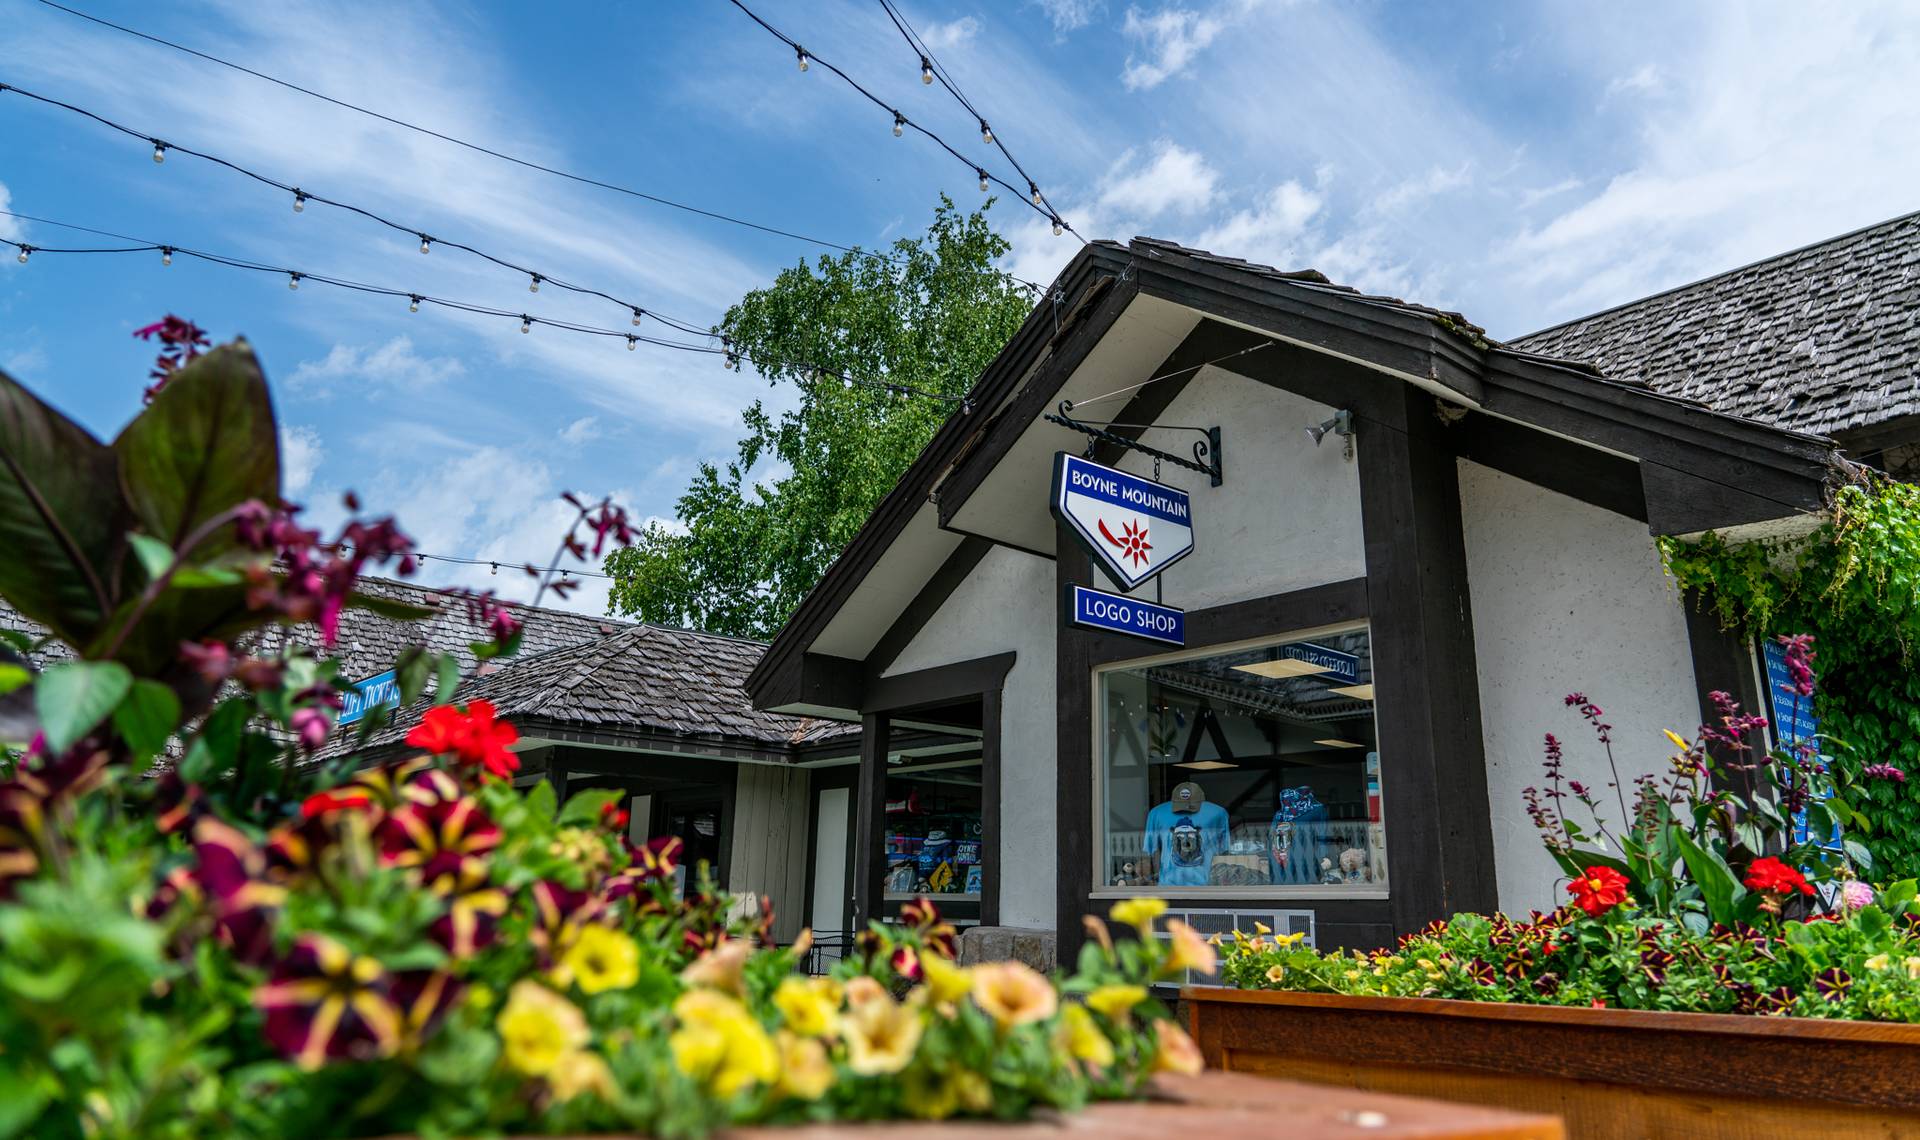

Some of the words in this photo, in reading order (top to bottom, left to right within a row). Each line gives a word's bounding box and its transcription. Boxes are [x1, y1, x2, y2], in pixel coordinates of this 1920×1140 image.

[1072, 470, 1118, 497] BOYNE
[1122, 485, 1187, 518] MOUNTAIN
[1086, 597, 1130, 623] LOGO
[1137, 610, 1176, 633] SHOP
[341, 690, 362, 717] LIFT
[363, 679, 400, 710] TICKETS
